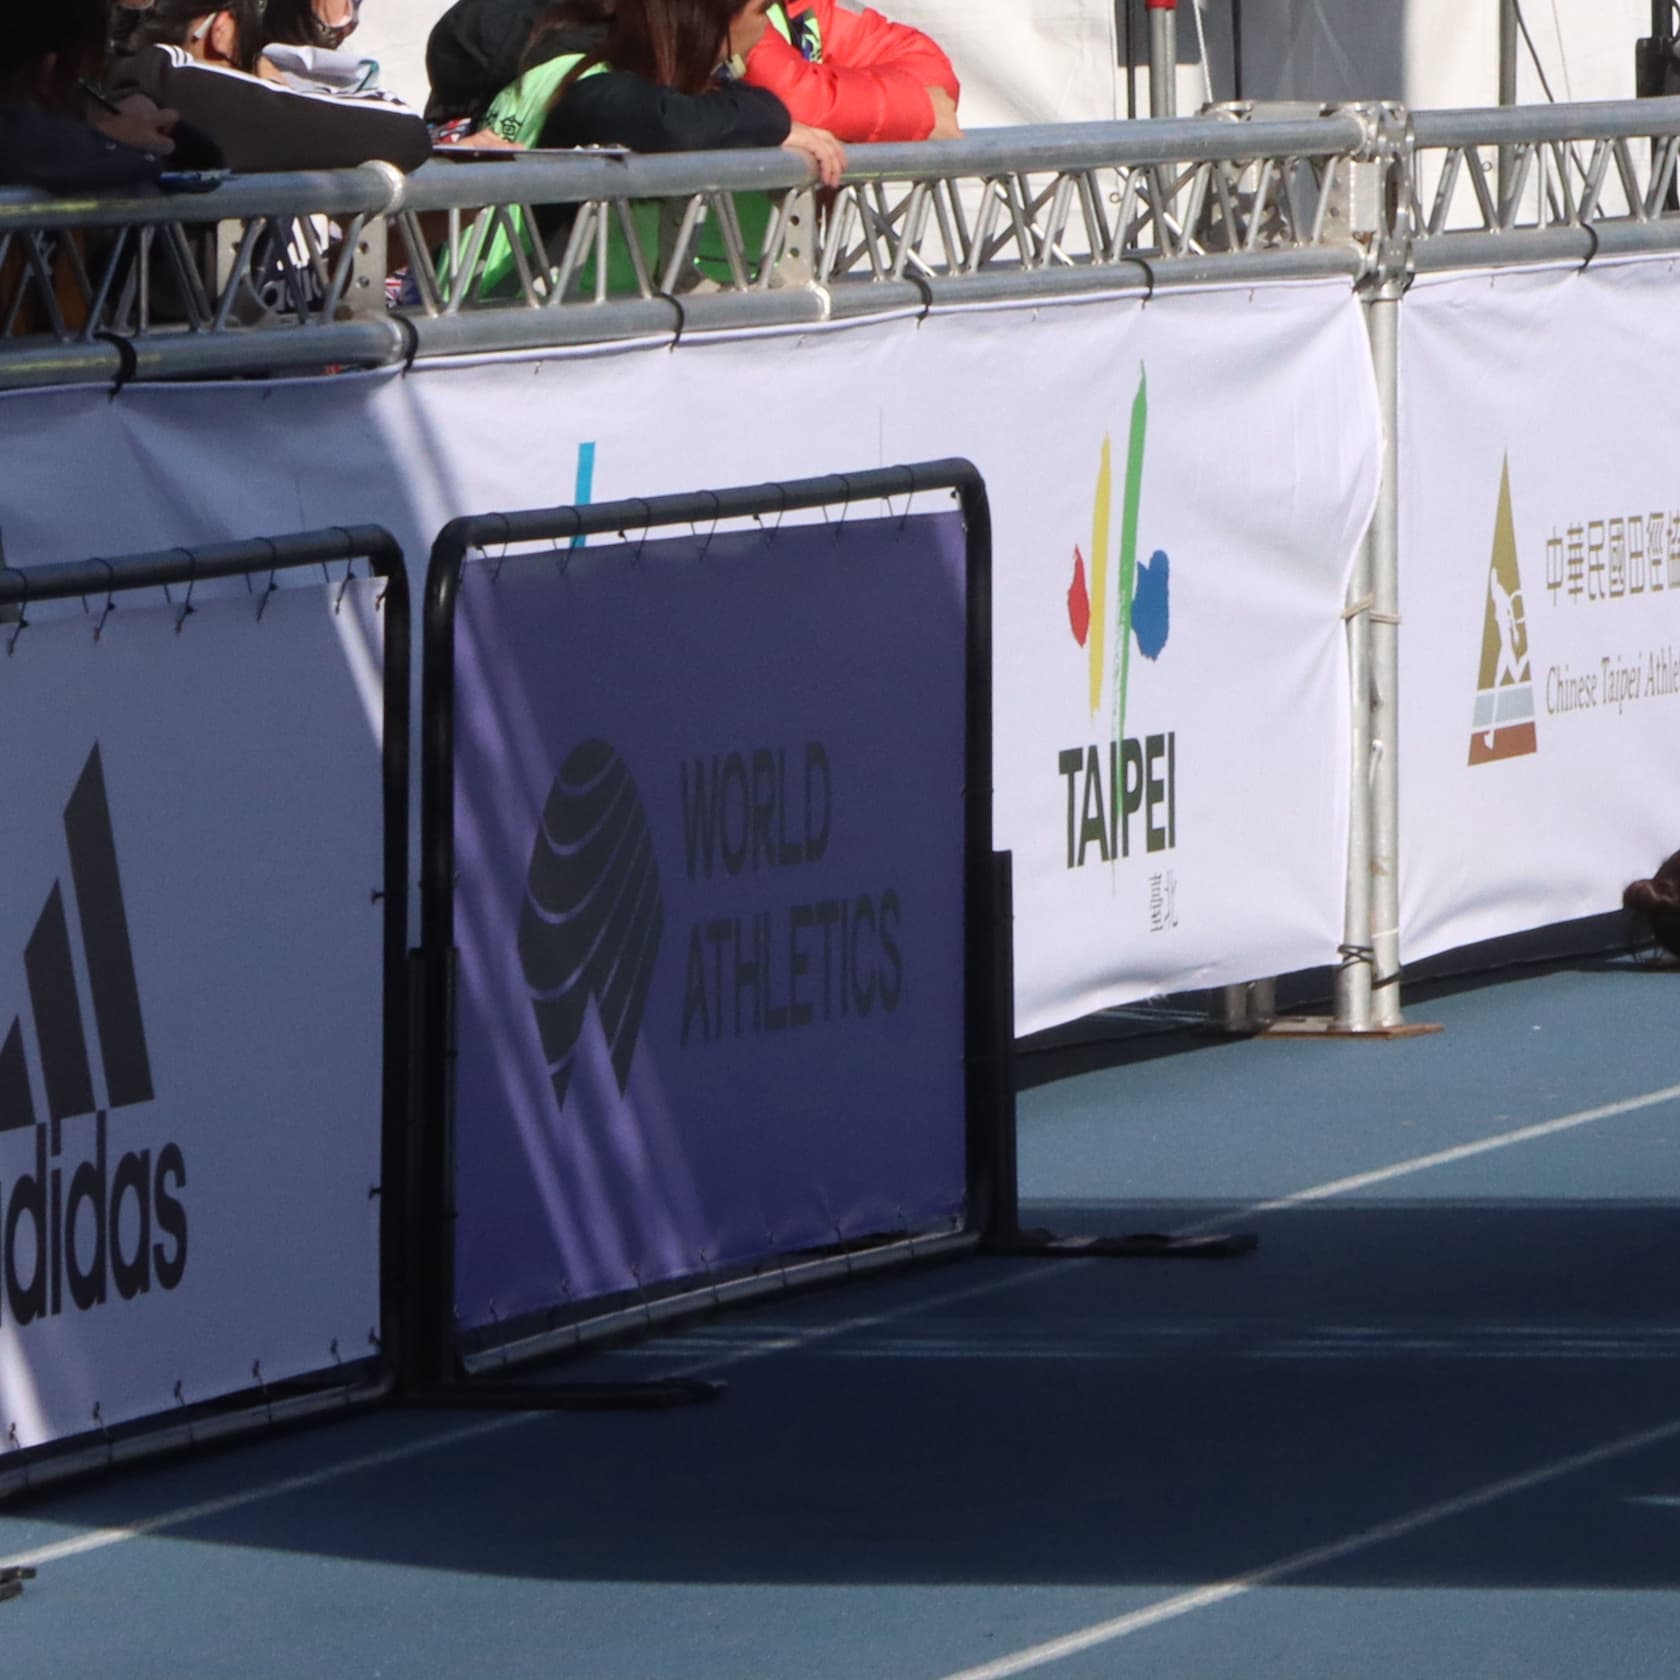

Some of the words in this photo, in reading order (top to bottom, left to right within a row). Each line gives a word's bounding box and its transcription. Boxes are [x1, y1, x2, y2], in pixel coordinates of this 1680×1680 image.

[1546, 663, 1598, 716] Chinese
[1601, 650, 1642, 716] Taipei
[681, 740, 833, 882] WORLD
[1058, 731, 1176, 871] TAIPEI
[680, 887, 902, 1050] ATHLETICS
